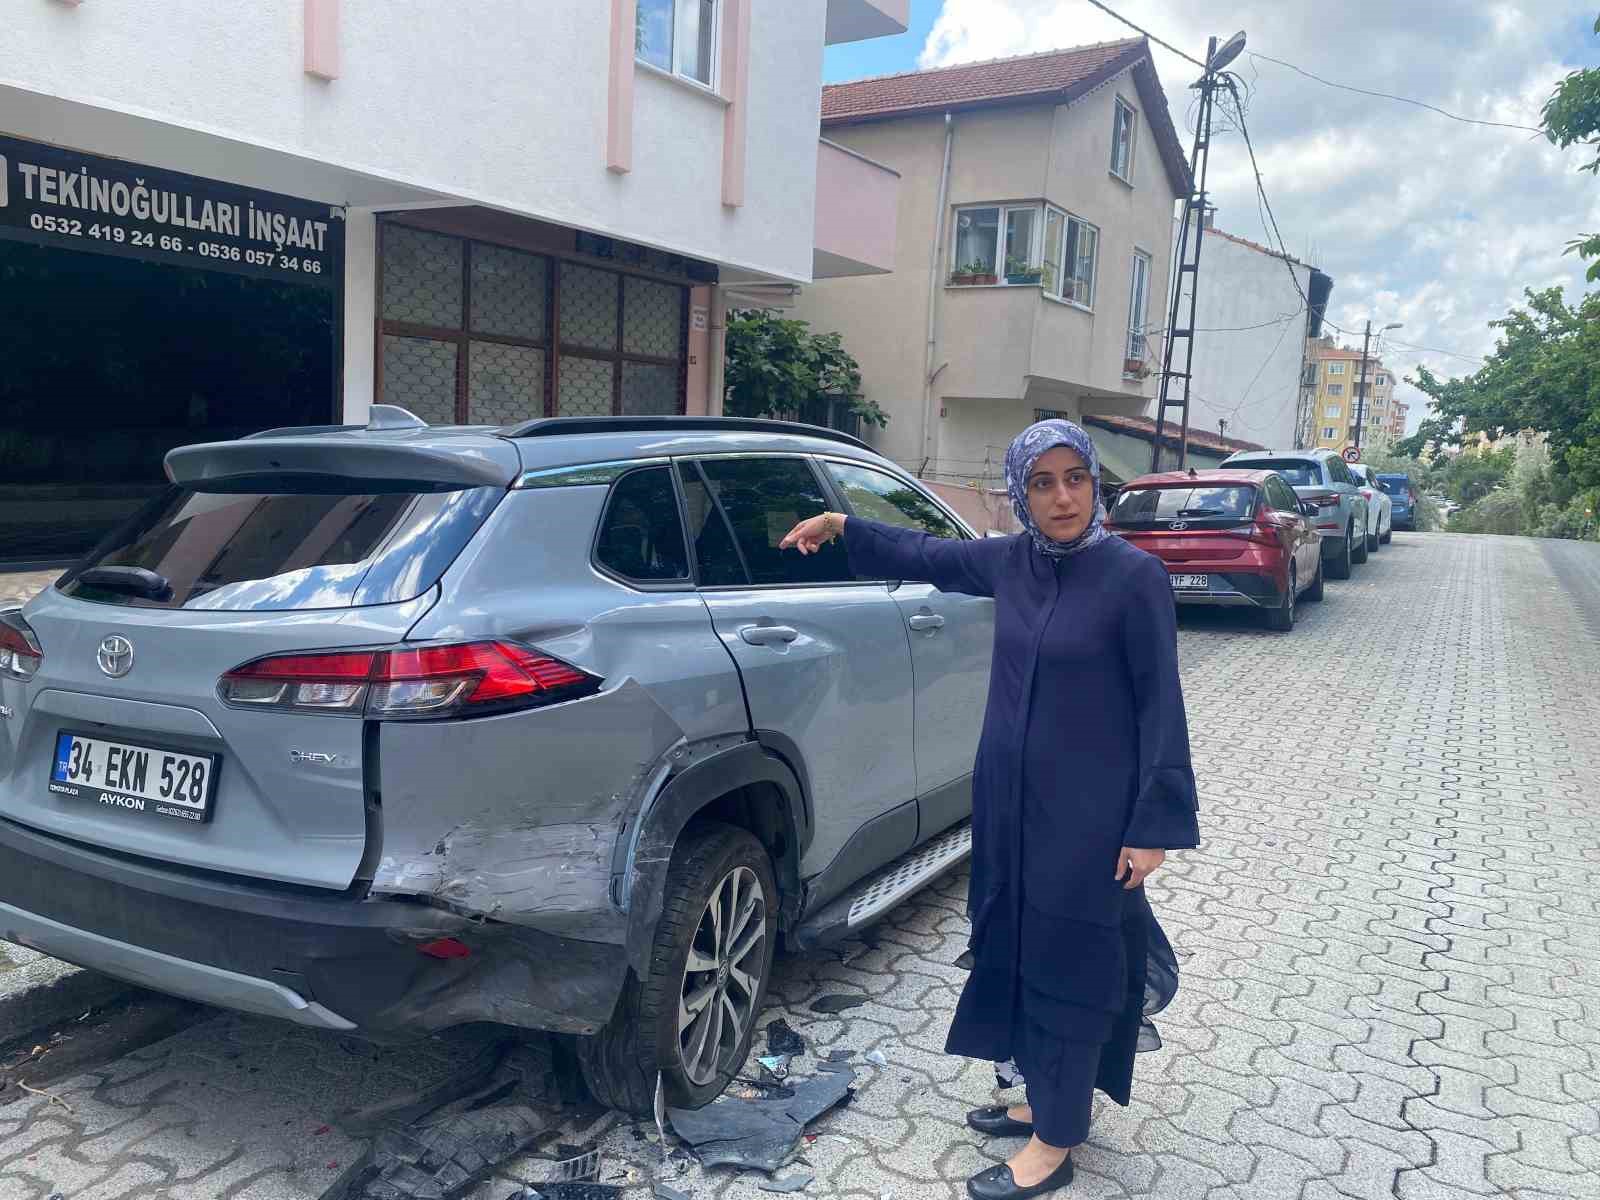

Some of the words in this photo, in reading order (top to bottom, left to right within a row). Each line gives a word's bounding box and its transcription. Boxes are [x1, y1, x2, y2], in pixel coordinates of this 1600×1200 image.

[18, 162, 240, 236] TEKİNOĞULLARI
[249, 201, 328, 251] İNŞAAT
[30, 213, 82, 236] 0532
[88, 223, 125, 242] 419
[131, 230, 154, 248] 24
[160, 235, 183, 252] 66
[199, 242, 241, 261] 0536
[245, 249, 275, 266] 057
[279, 256, 299, 271] 34
[303, 260, 321, 274] 66
[1190, 575, 1207, 586] 228
[58, 761, 68, 772] TR
[68, 741, 93, 782] 34
[105, 746, 149, 793] EKN
[160, 756, 205, 803] 528
[99, 792, 145, 811] AYKON
